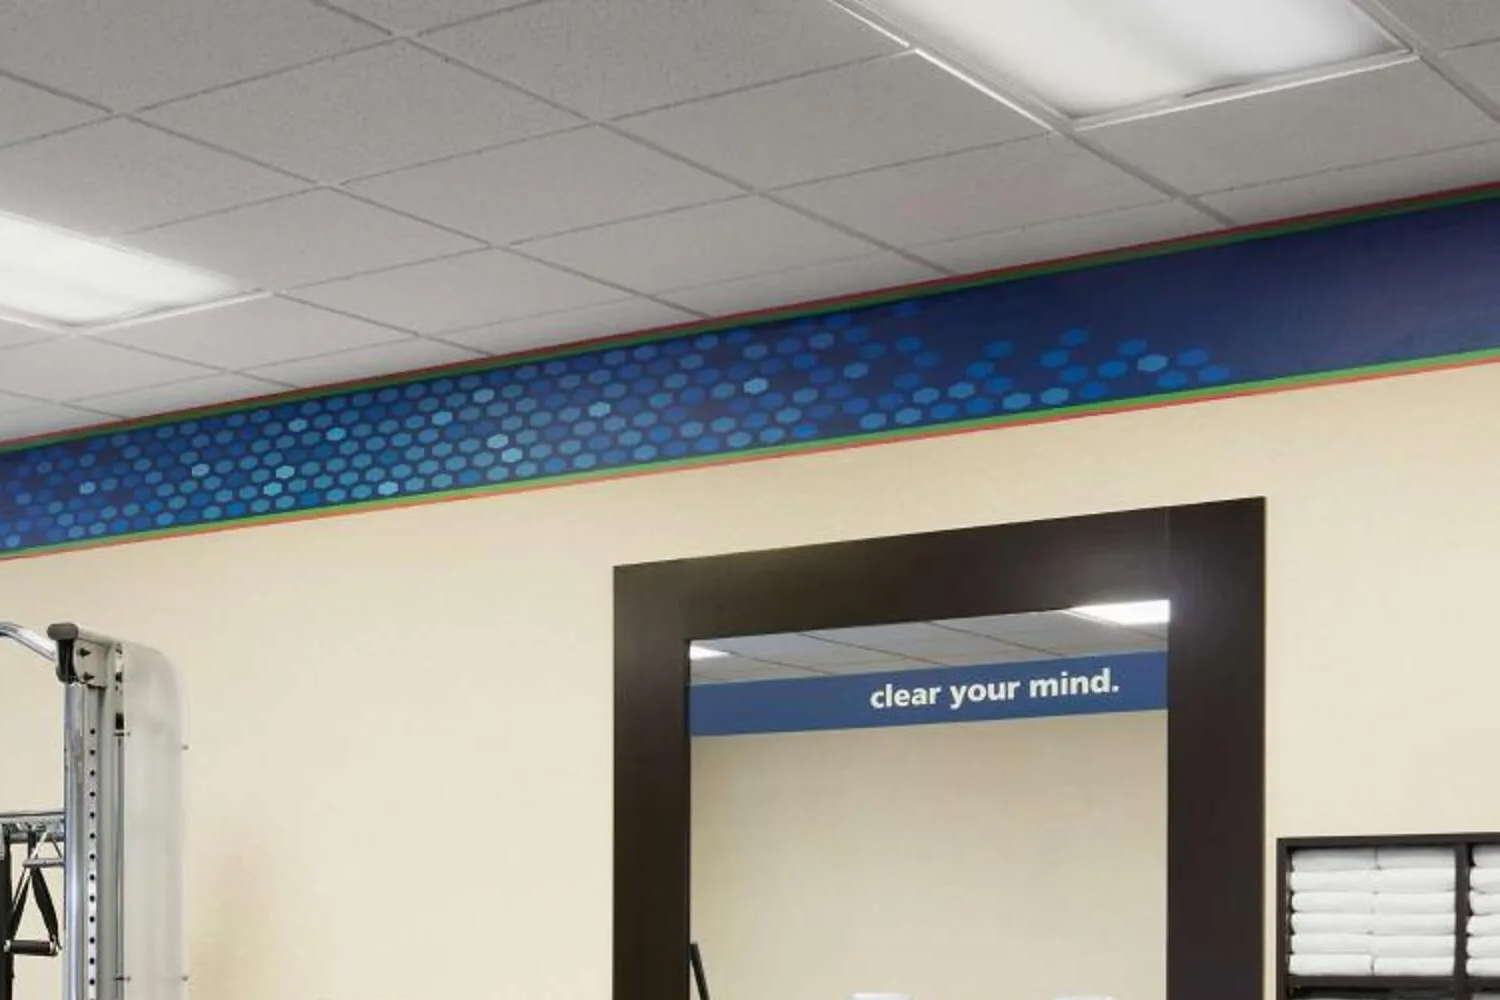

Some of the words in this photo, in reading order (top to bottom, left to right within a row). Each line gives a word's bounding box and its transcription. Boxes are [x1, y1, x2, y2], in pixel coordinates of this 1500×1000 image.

[870, 684, 941, 708] clear
[950, 680, 1021, 709] your
[1029, 667, 1120, 697] mind.
